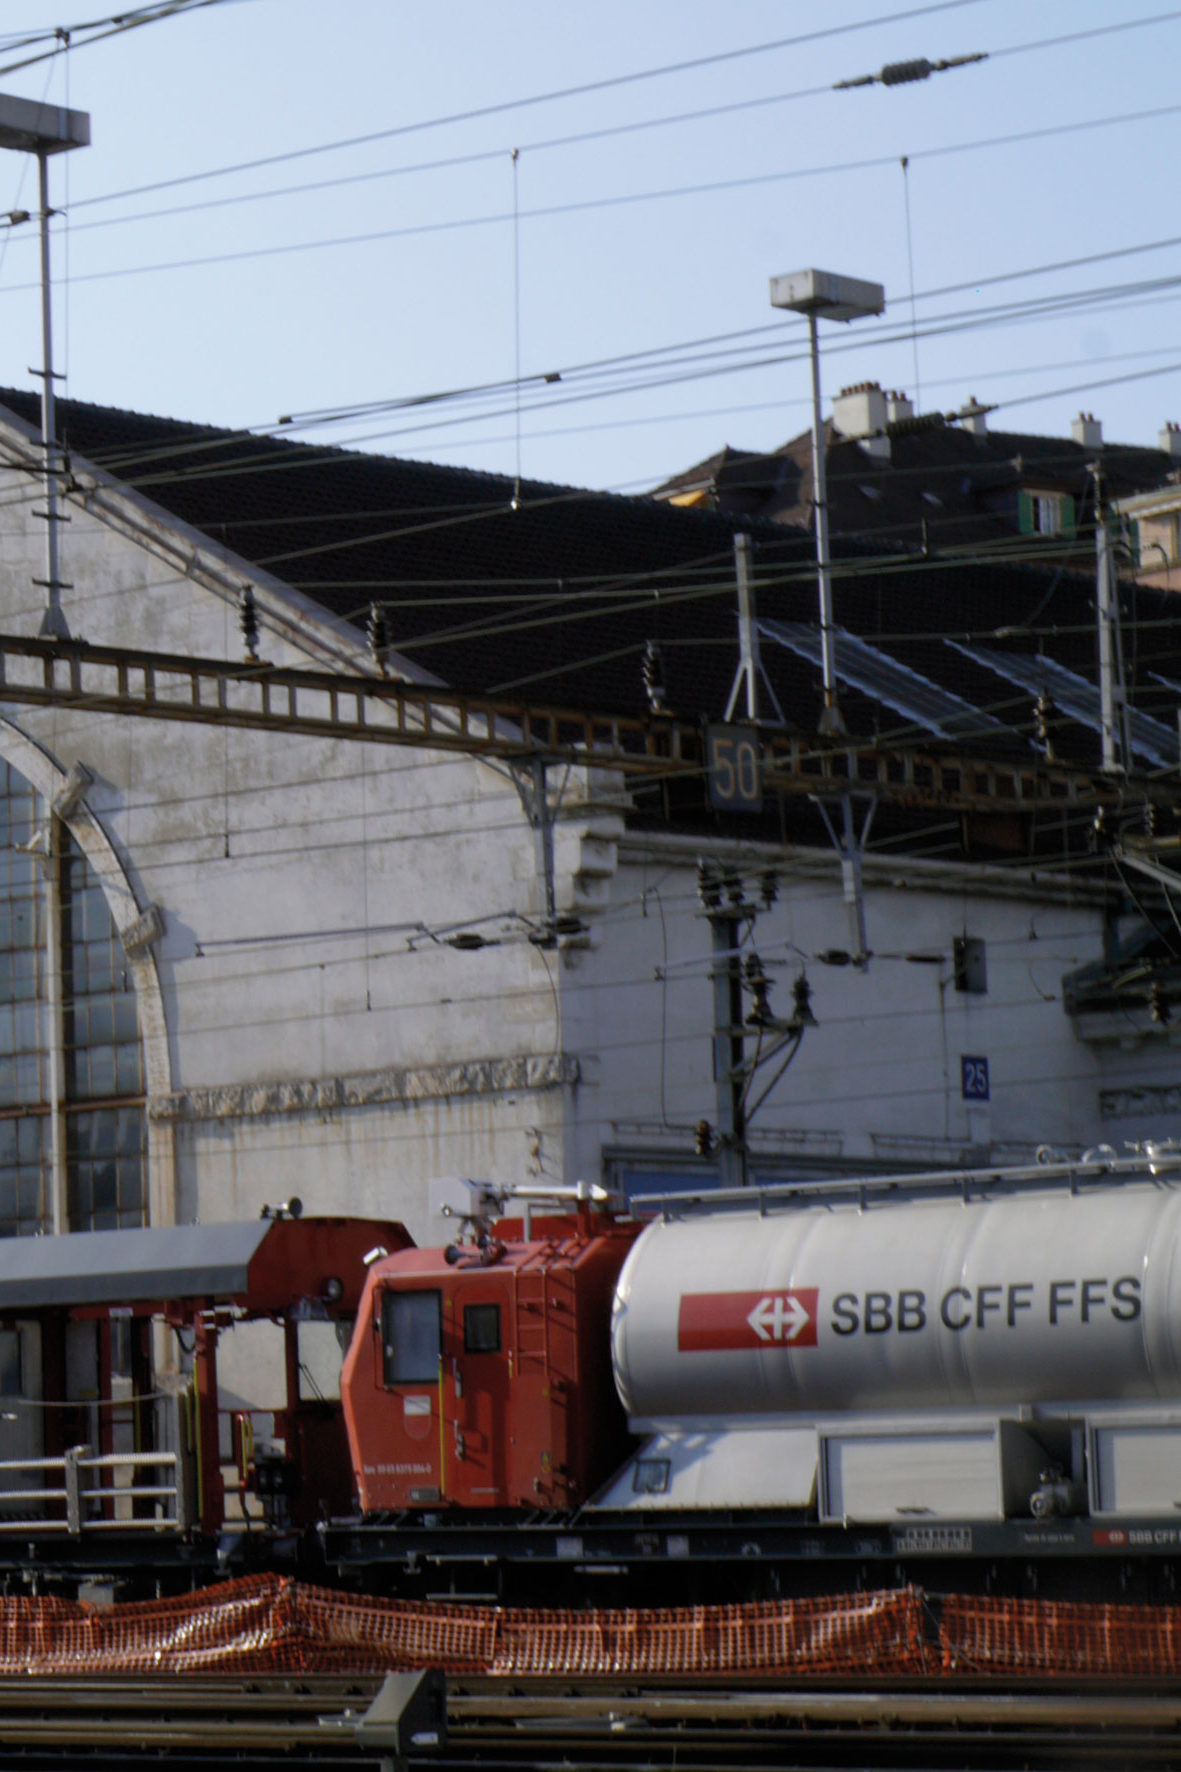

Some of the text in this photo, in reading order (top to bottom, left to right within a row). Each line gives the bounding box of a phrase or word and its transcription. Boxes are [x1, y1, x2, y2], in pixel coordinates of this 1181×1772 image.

[713, 737, 758, 800] 50
[965, 1062, 987, 1092] 25
[830, 1275, 1142, 1336] SBB CFF FFS
